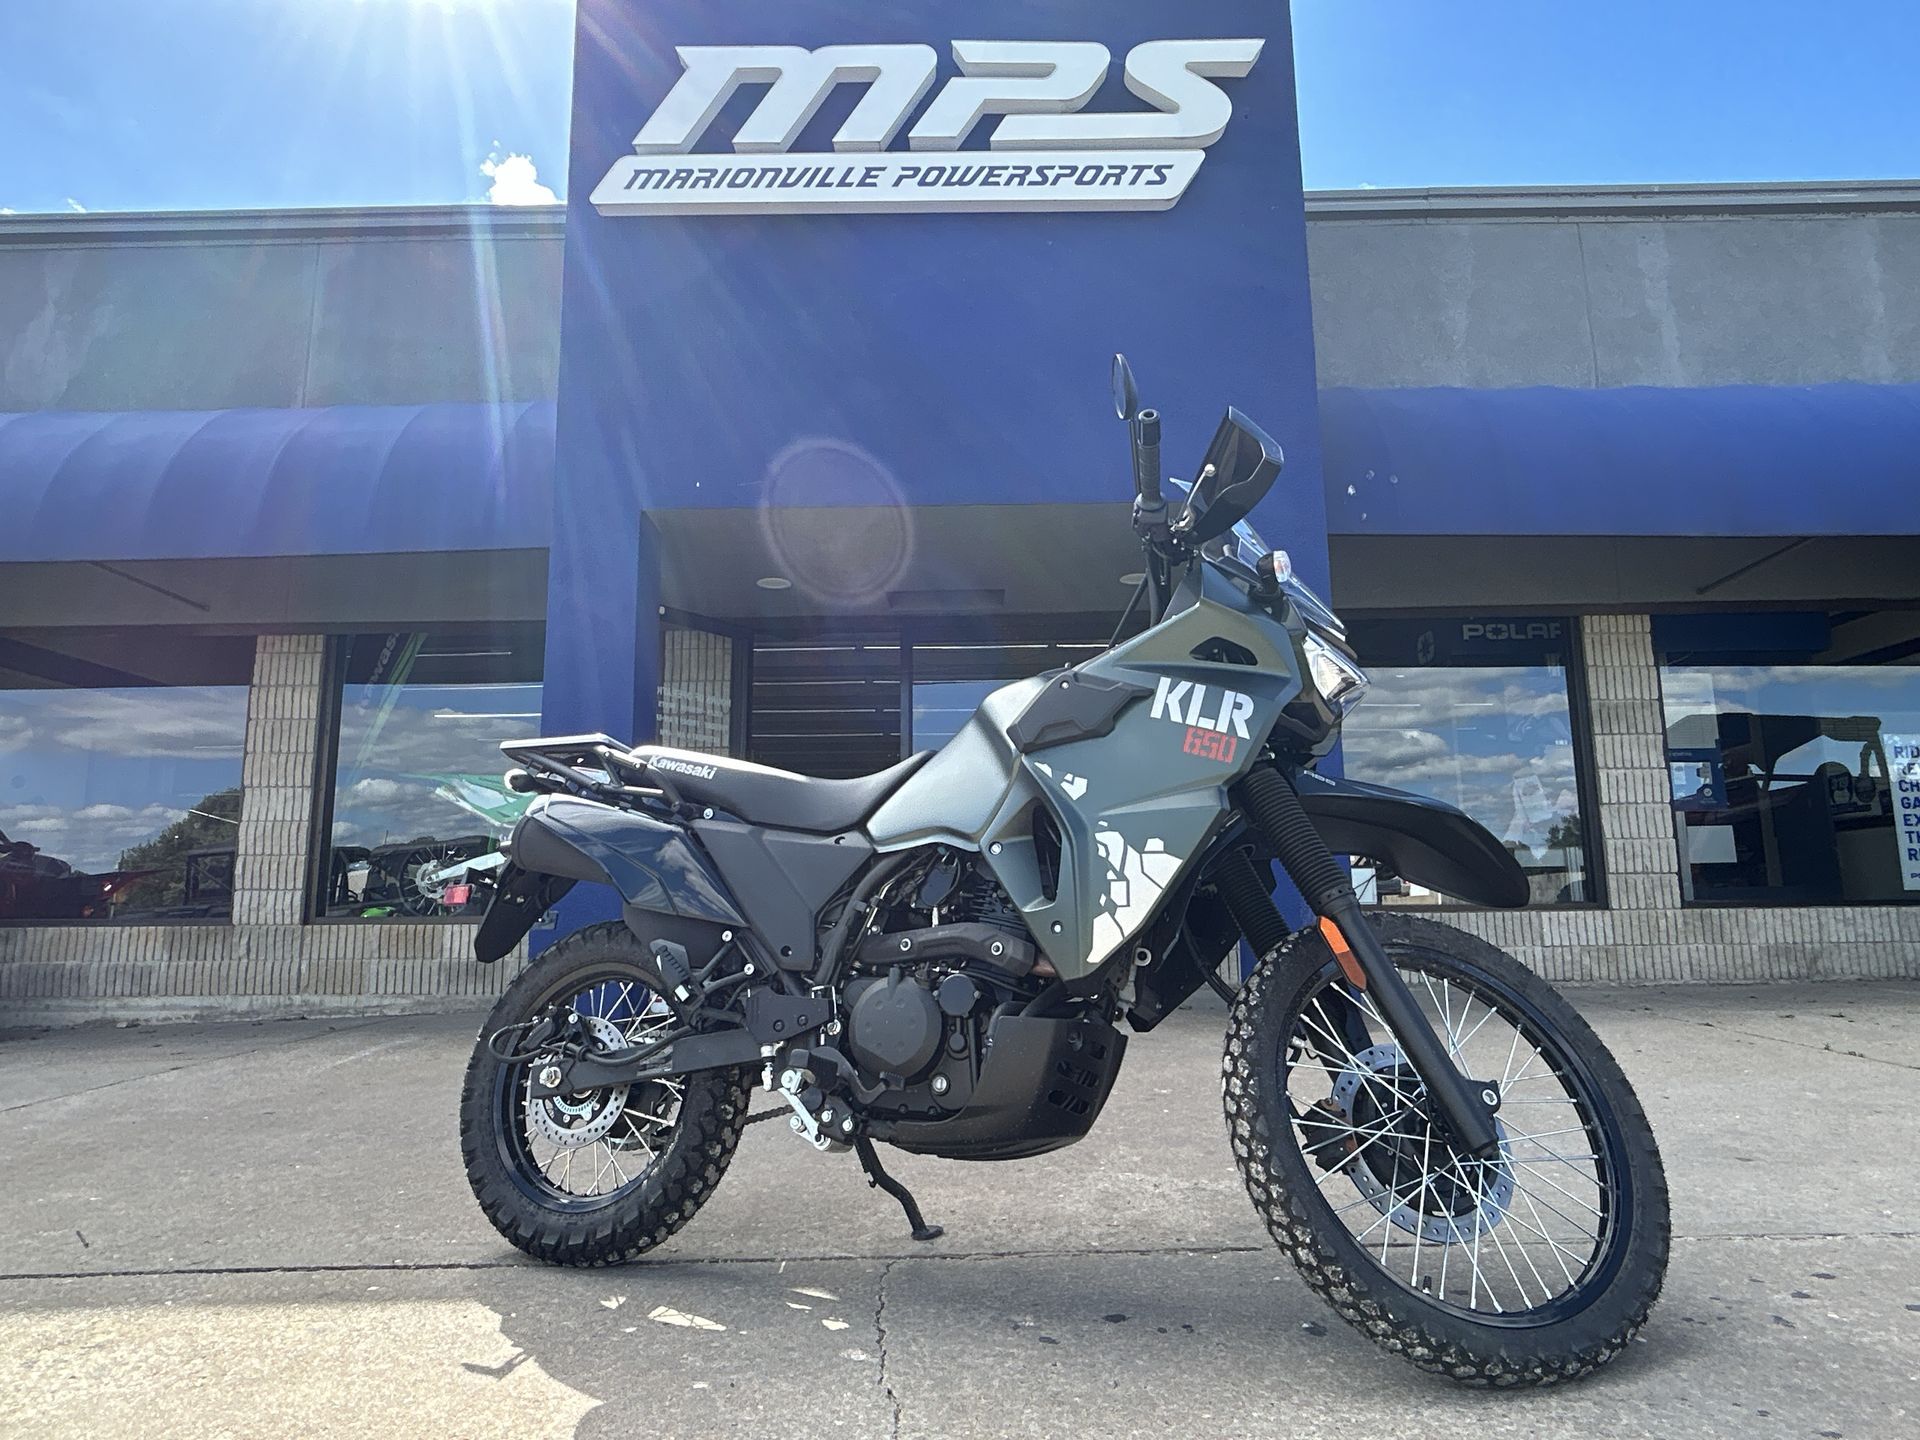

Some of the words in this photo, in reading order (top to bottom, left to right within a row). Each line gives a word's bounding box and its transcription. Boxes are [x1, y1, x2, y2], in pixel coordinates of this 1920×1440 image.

[631, 38, 1266, 153] MPS
[623, 166, 887, 190] MARIONVILLE
[892, 164, 1174, 187] POWERSPORTS
[1150, 676, 1254, 740] KLR
[1182, 726, 1237, 764] 650
[647, 755, 718, 779] Kawasaki
